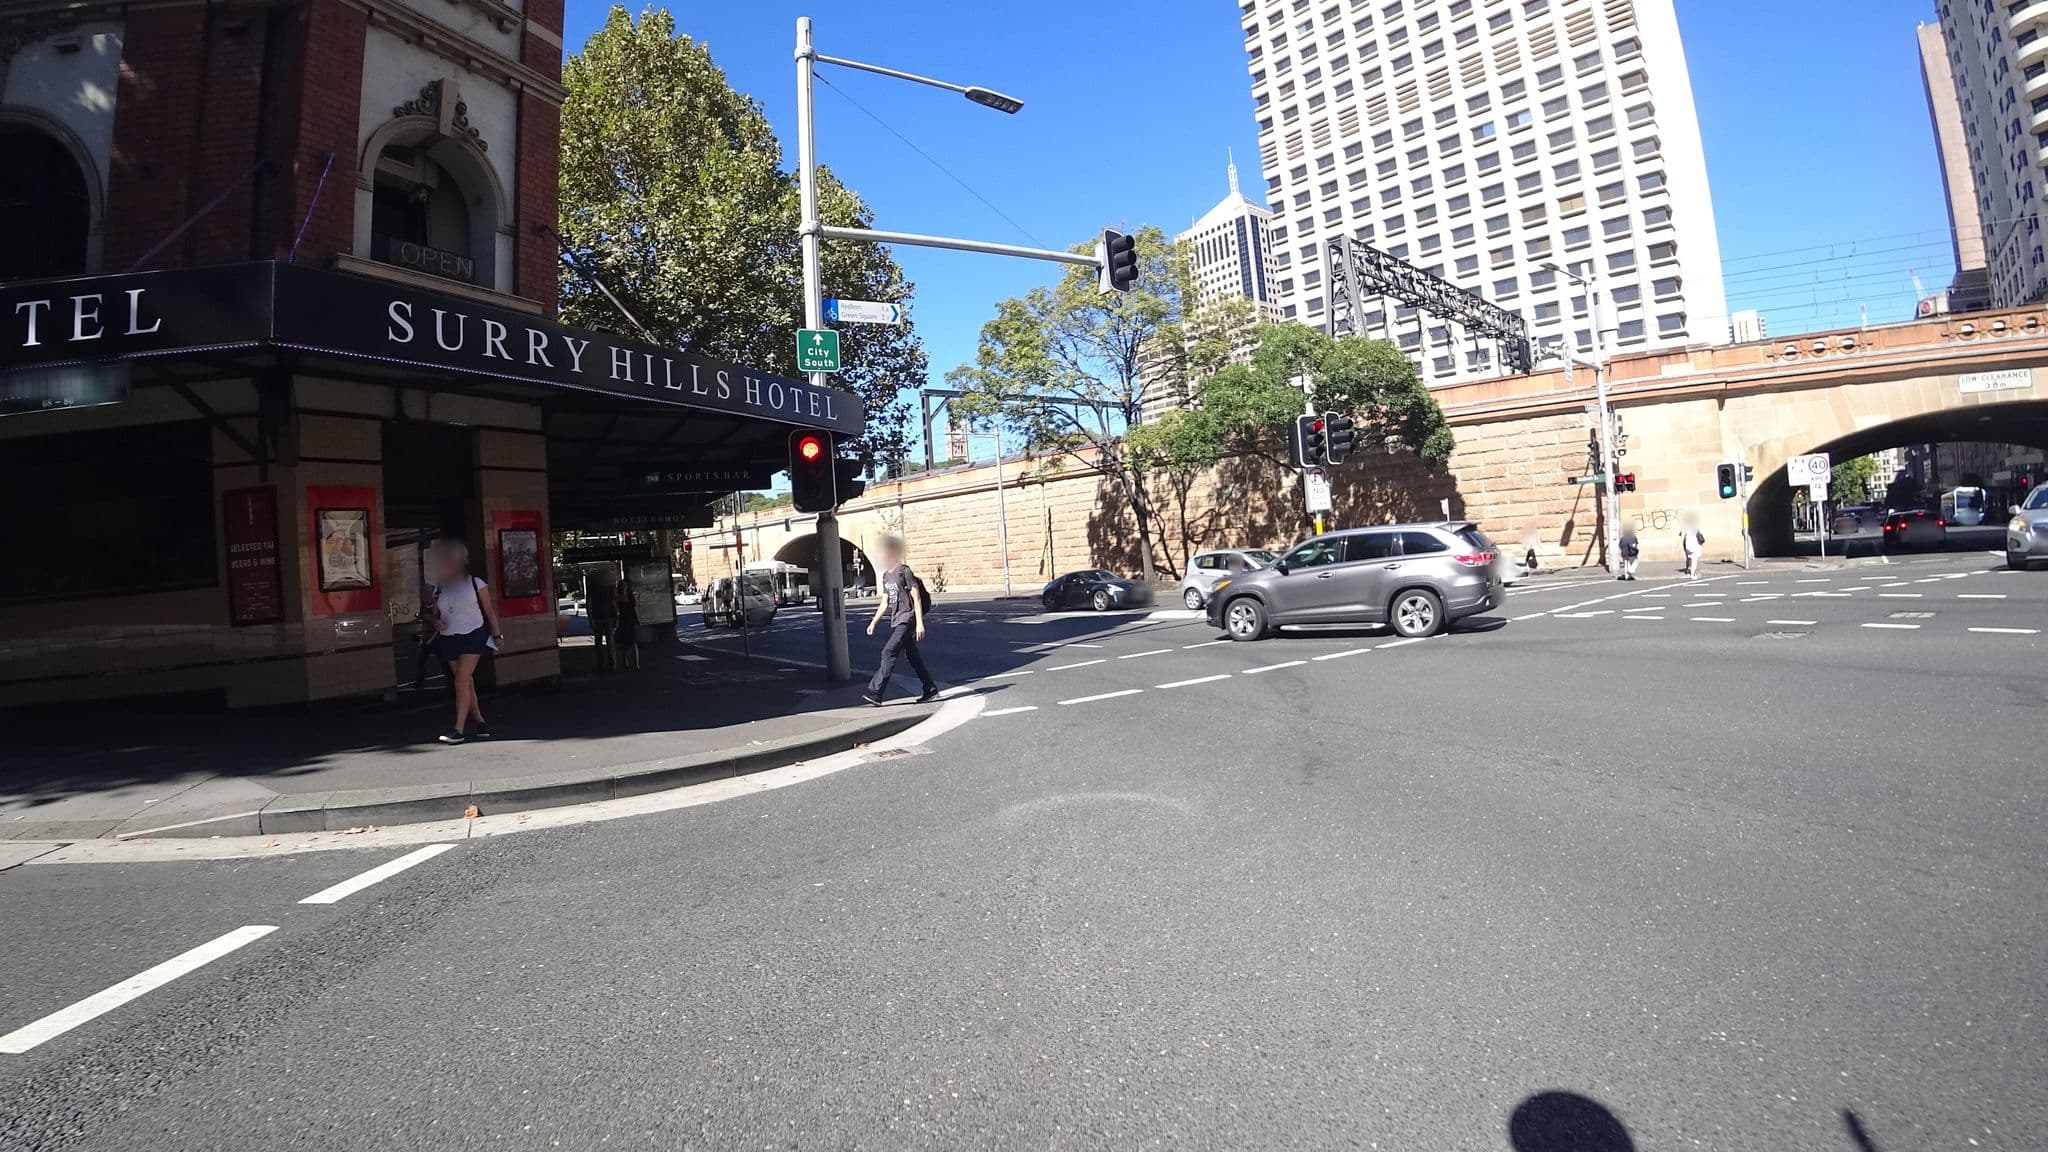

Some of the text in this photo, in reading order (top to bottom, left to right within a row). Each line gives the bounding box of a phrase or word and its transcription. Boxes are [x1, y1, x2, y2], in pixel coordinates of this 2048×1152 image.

[401, 241, 474, 277] OPEN
[15, 289, 162, 347] TEL
[841, 311, 858, 319] Green
[859, 312, 878, 320] Square
[807, 347, 830, 358] City
[388, 301, 838, 421] SURRY HILLS HOTEL
[804, 358, 834, 368] South
[1961, 370, 2029, 384] LOW CLEARANCE
[1811, 460, 1826, 470] 40
[667, 470, 751, 481] SPORTS BAR
